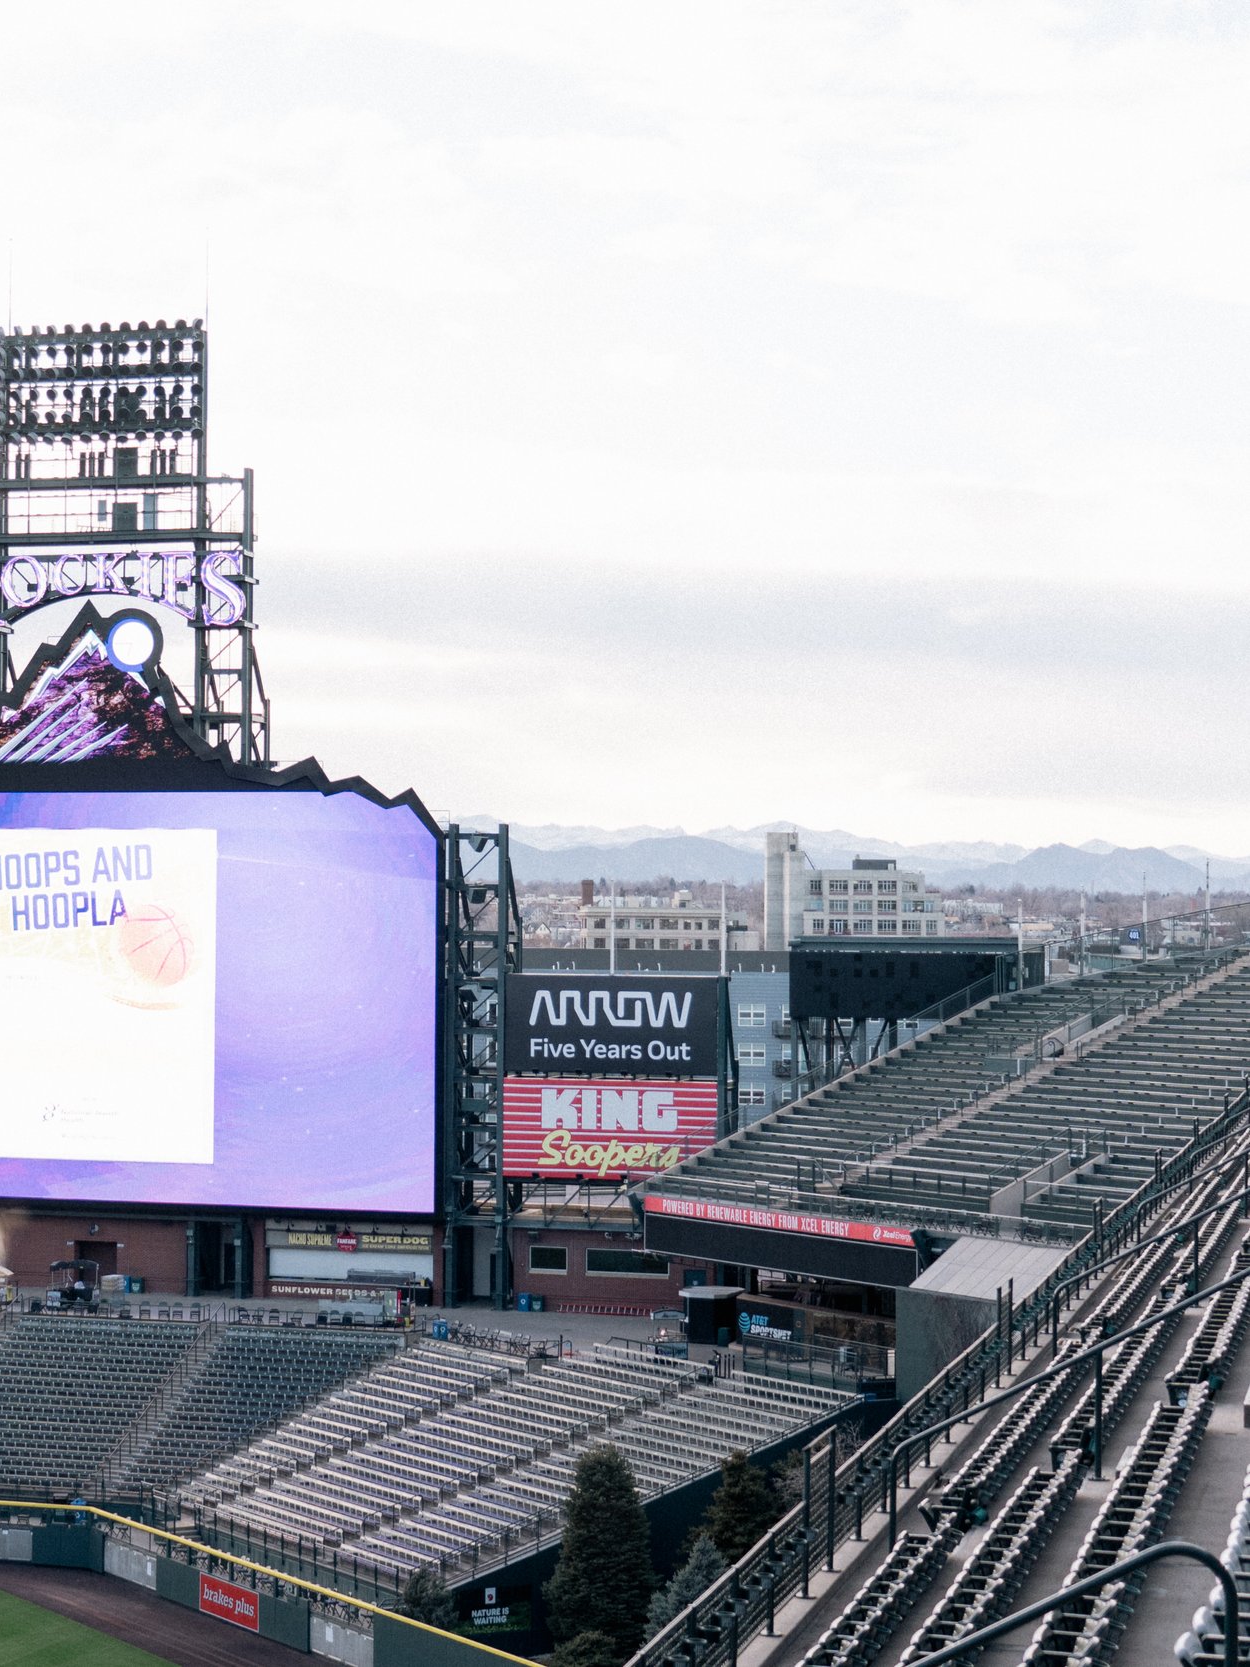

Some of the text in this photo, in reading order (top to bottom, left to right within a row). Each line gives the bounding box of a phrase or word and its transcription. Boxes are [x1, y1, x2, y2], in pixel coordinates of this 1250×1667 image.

[92, 844, 153, 884] AND
[11, 889, 128, 931] HOOPLA
[528, 989, 692, 1028] ARROW
[530, 1038, 691, 1061] Five Years Out
[541, 1088, 678, 1132] KING
[537, 1129, 681, 1177] Soopers
[662, 1199, 850, 1237] POWERED BY RENEWABLE ENERGY FROM XCEL ENERGY
[288, 1232, 332, 1246] NACHO SUPREME
[362, 1234, 429, 1245] SUPER DOG
[271, 1285, 333, 1295] SUNFLOWER
[751, 1314, 768, 1326] AT&T
[750, 1325, 792, 1340] SPORTSNET
[203, 1583, 234, 1609] brakes
[471, 1607, 510, 1618] NATURE IS
[473, 1615, 508, 1626] WAITING
